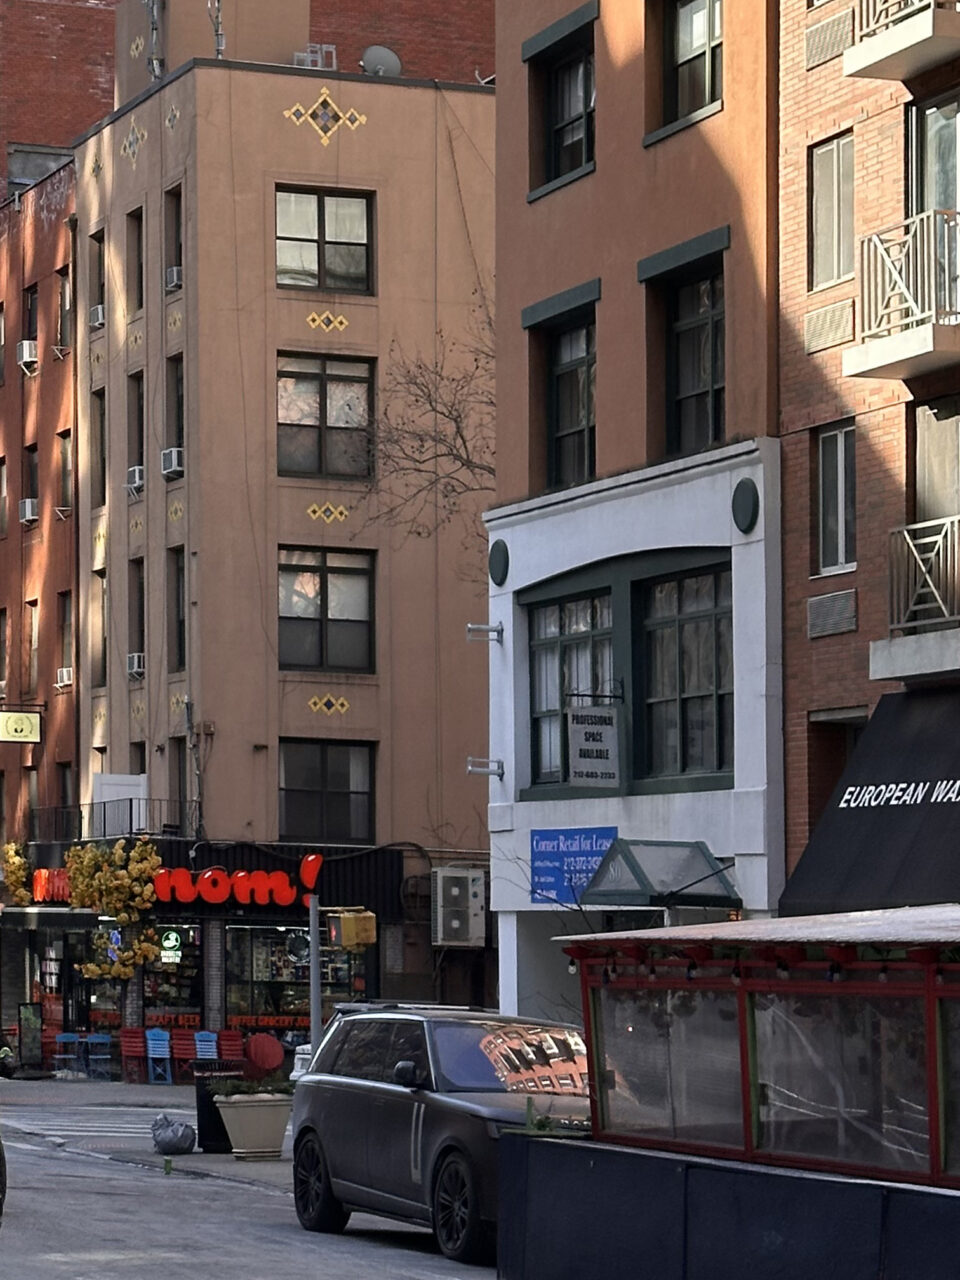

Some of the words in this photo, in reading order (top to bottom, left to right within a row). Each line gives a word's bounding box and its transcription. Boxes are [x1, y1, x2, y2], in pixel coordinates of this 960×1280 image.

[584, 731, 603, 743] SPACE
[579, 748, 609, 760] AVAILABLE
[839, 782, 930, 808] EUROPEAN
[930, 780, 960, 803] WA
[533, 836, 558, 852] Corner
[559, 835, 580, 851] Retail
